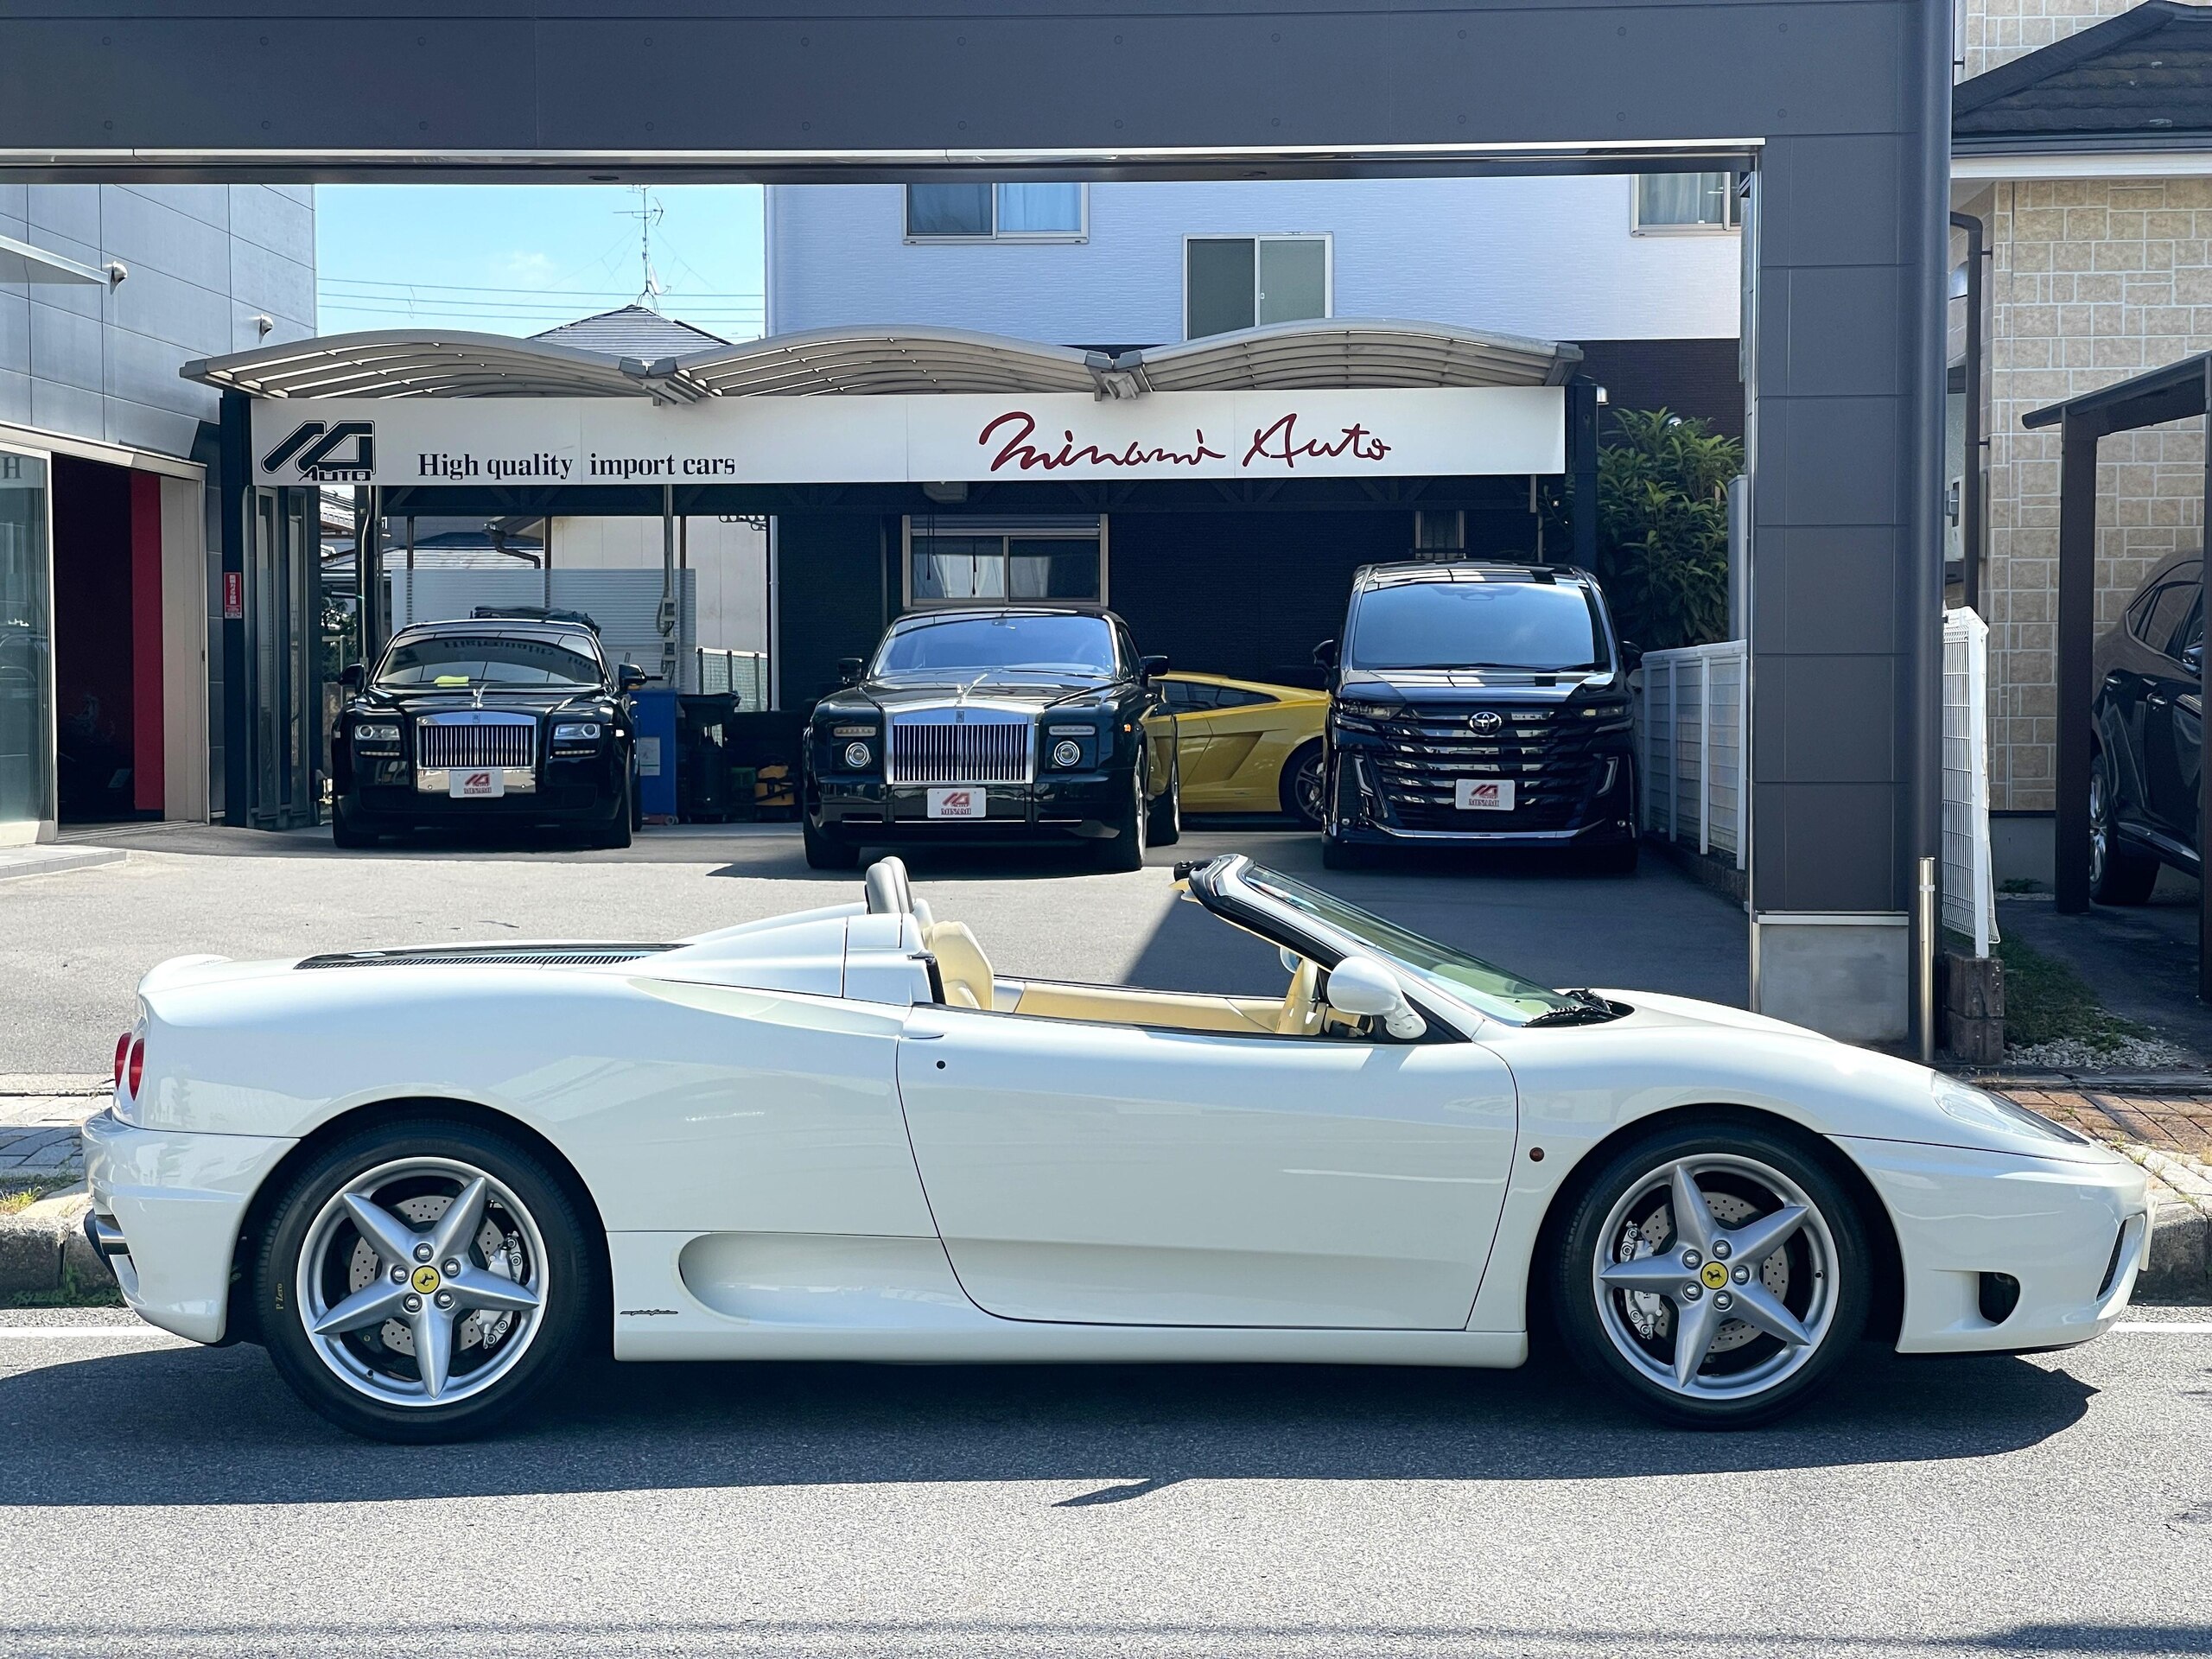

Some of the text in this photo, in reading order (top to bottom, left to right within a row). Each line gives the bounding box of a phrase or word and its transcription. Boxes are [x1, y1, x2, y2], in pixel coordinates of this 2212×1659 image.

[1243, 414, 1391, 467] Auto
[298, 465, 372, 482] AUTO
[418, 454, 734, 480] High quality import cars
